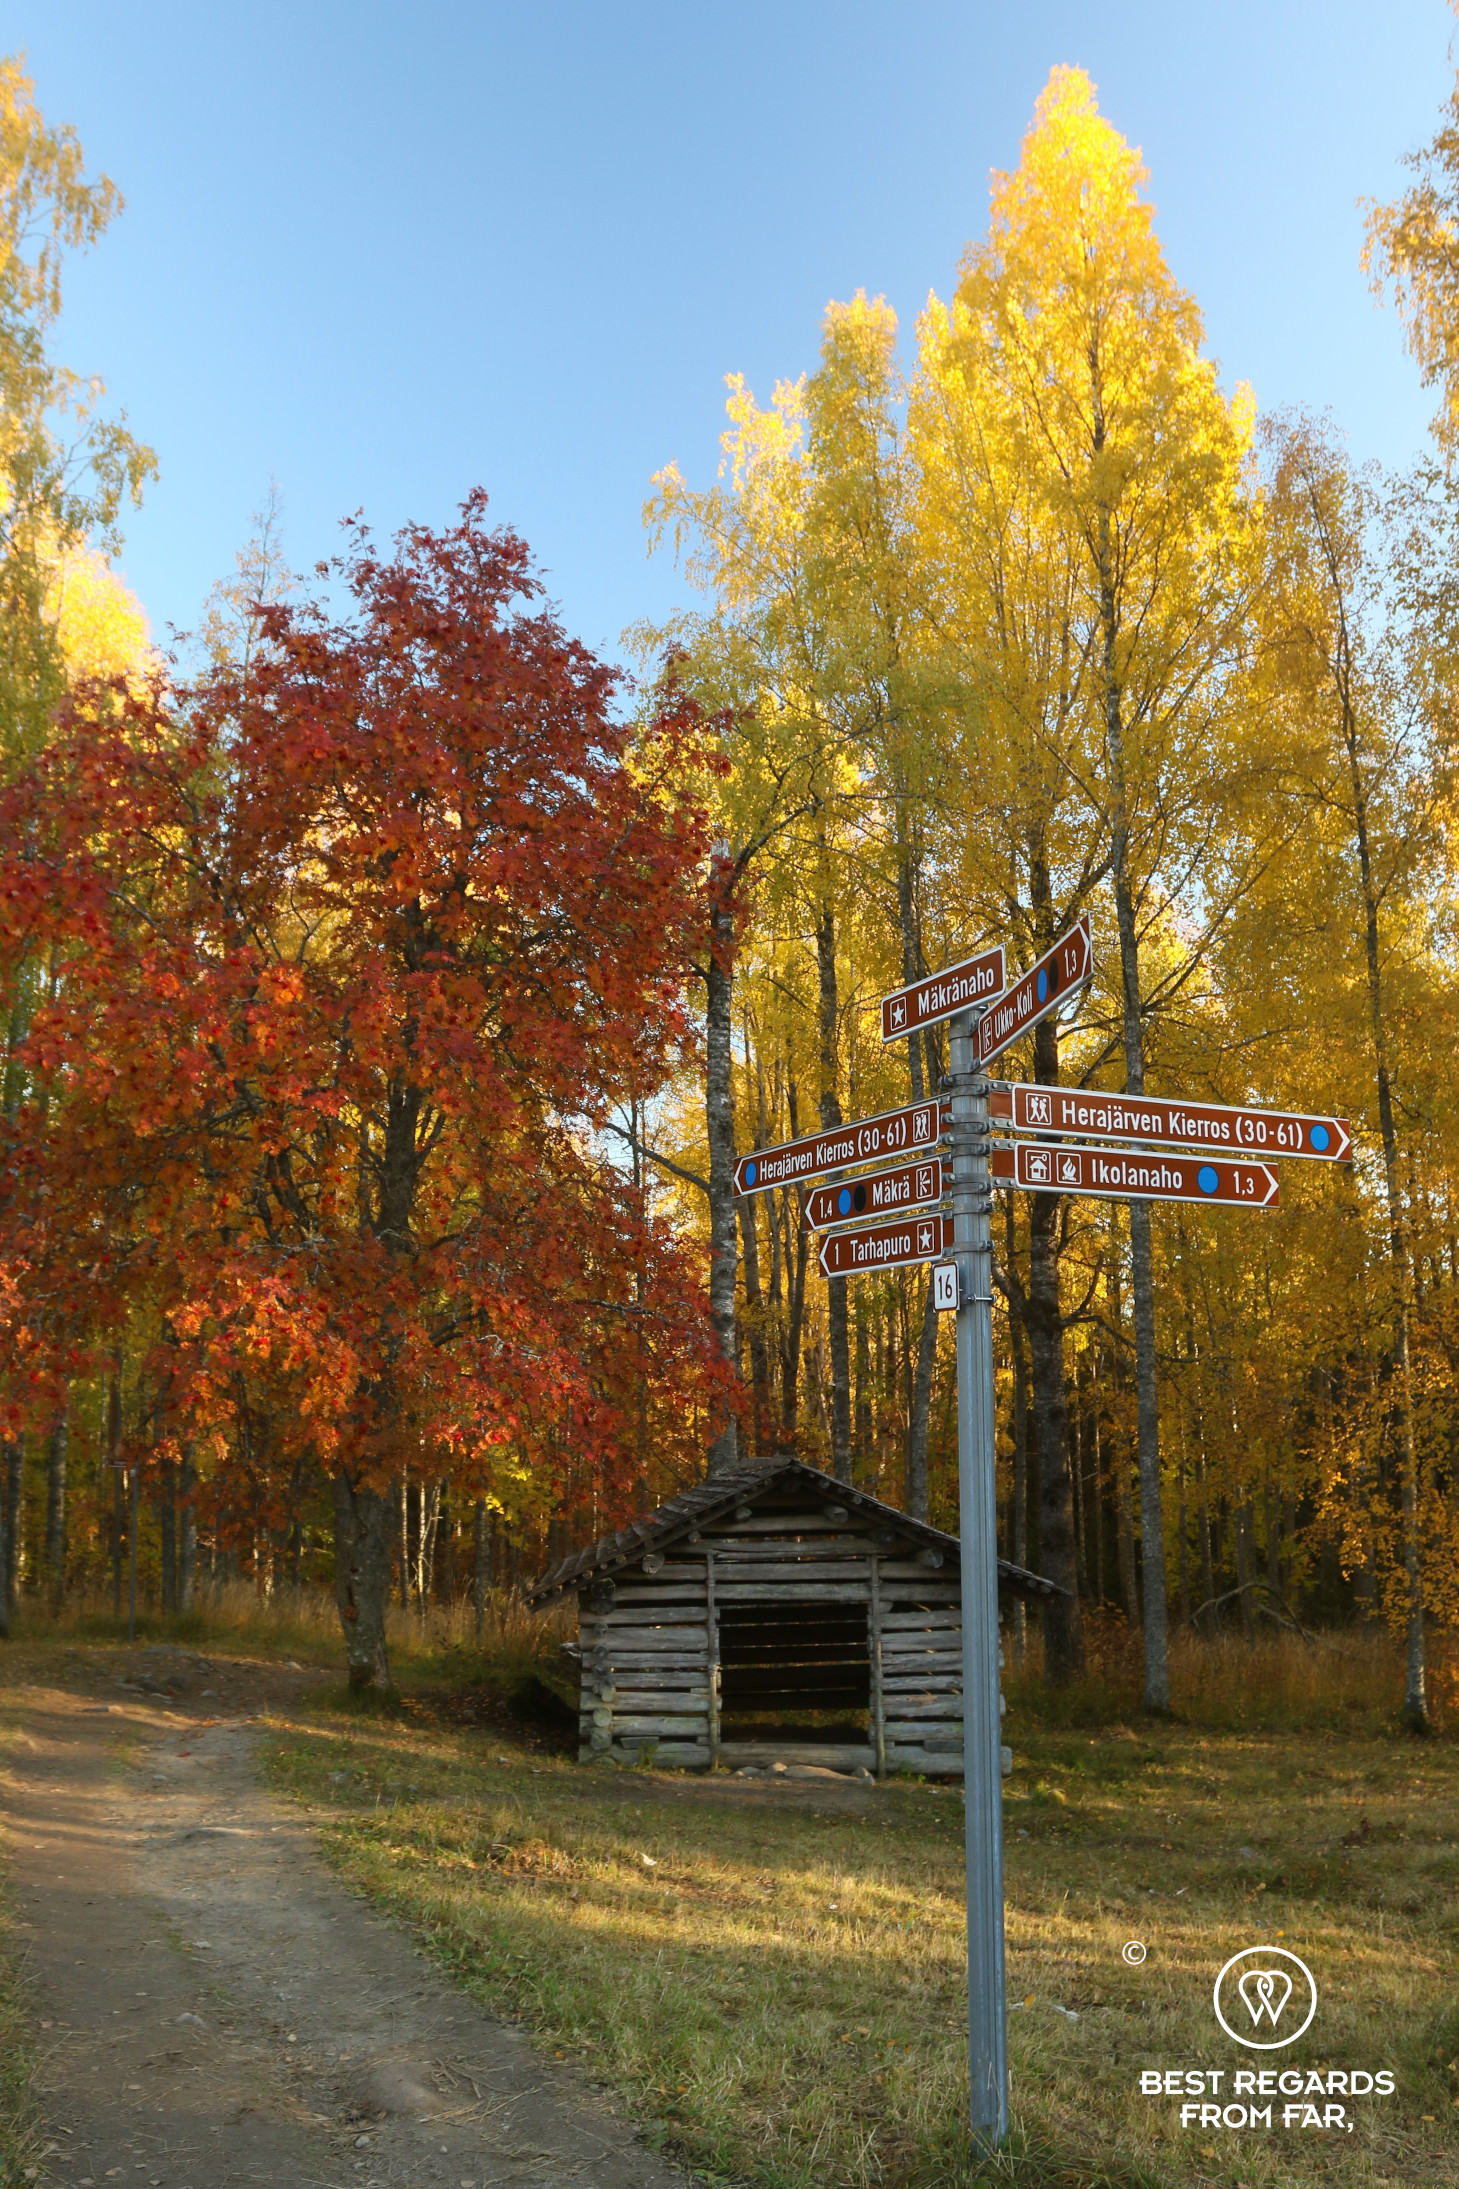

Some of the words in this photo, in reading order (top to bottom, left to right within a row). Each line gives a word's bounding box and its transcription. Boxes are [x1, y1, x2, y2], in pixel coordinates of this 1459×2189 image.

[918, 967, 994, 1016] Mäkränaho
[994, 983, 1033, 1038] Ukko-Koli
[1062, 1100, 1162, 1133] Herajärven
[1169, 1112, 1230, 1140] Kierros
[1235, 1116, 1303, 1149] (30-61)
[760, 1152, 813, 1181] Herajärven
[816, 1139, 855, 1166] Kierros
[857, 1117, 907, 1156] (30-61)
[819, 1196, 833, 1219] 1,4
[872, 1175, 910, 1206] Mäkrä
[1092, 1159, 1183, 1189] Ikolanaho
[1233, 1171, 1255, 1196] 1,3
[834, 1243, 840, 1266] 1
[850, 1236, 911, 1263] Tarhapuro
[938, 1274, 953, 1300] 16
